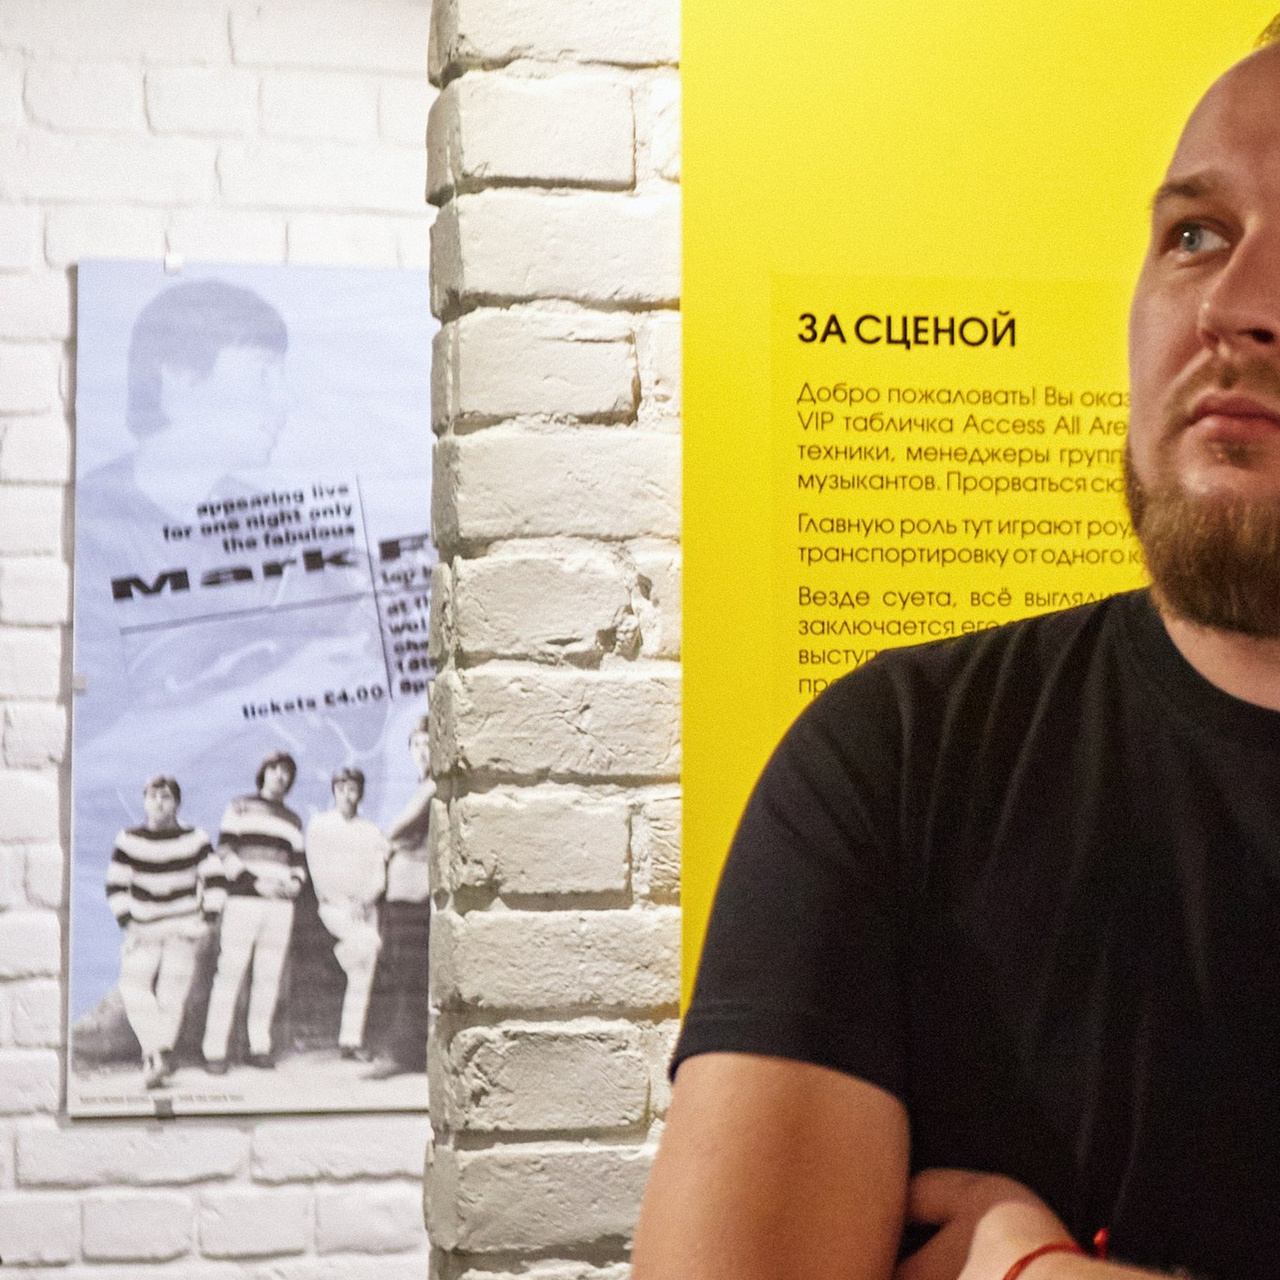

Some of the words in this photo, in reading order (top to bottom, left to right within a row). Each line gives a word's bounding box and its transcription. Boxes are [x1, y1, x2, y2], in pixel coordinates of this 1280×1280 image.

[797, 313, 846, 344] ЗА
[854, 311, 1016, 350] СЦЕНОЙ
[797, 382, 881, 406] Добро
[888, 386, 1036, 407] пожаловать!
[1045, 388, 1073, 406] Вы
[797, 412, 834, 431] VIP
[844, 415, 953, 433] табличка
[962, 415, 1044, 434] Access
[1054, 417, 1080, 435] All
[799, 445, 895, 463] техники,
[906, 447, 1049, 466] менеджеры
[797, 473, 940, 494] музыкантов.
[946, 472, 1086, 495] Прорваться
[798, 513, 894, 537] Главную
[899, 518, 956, 538] роль
[963, 520, 991, 538] тут
[998, 521, 1082, 539] играют
[799, 545, 1009, 567] транспортировку
[1013, 548, 1037, 564] от
[1041, 549, 1124, 566] одного
[798, 587, 869, 608] Везде
[882, 590, 956, 611] суета,
[970, 587, 1012, 606] всё
[799, 620, 955, 635] заключается
